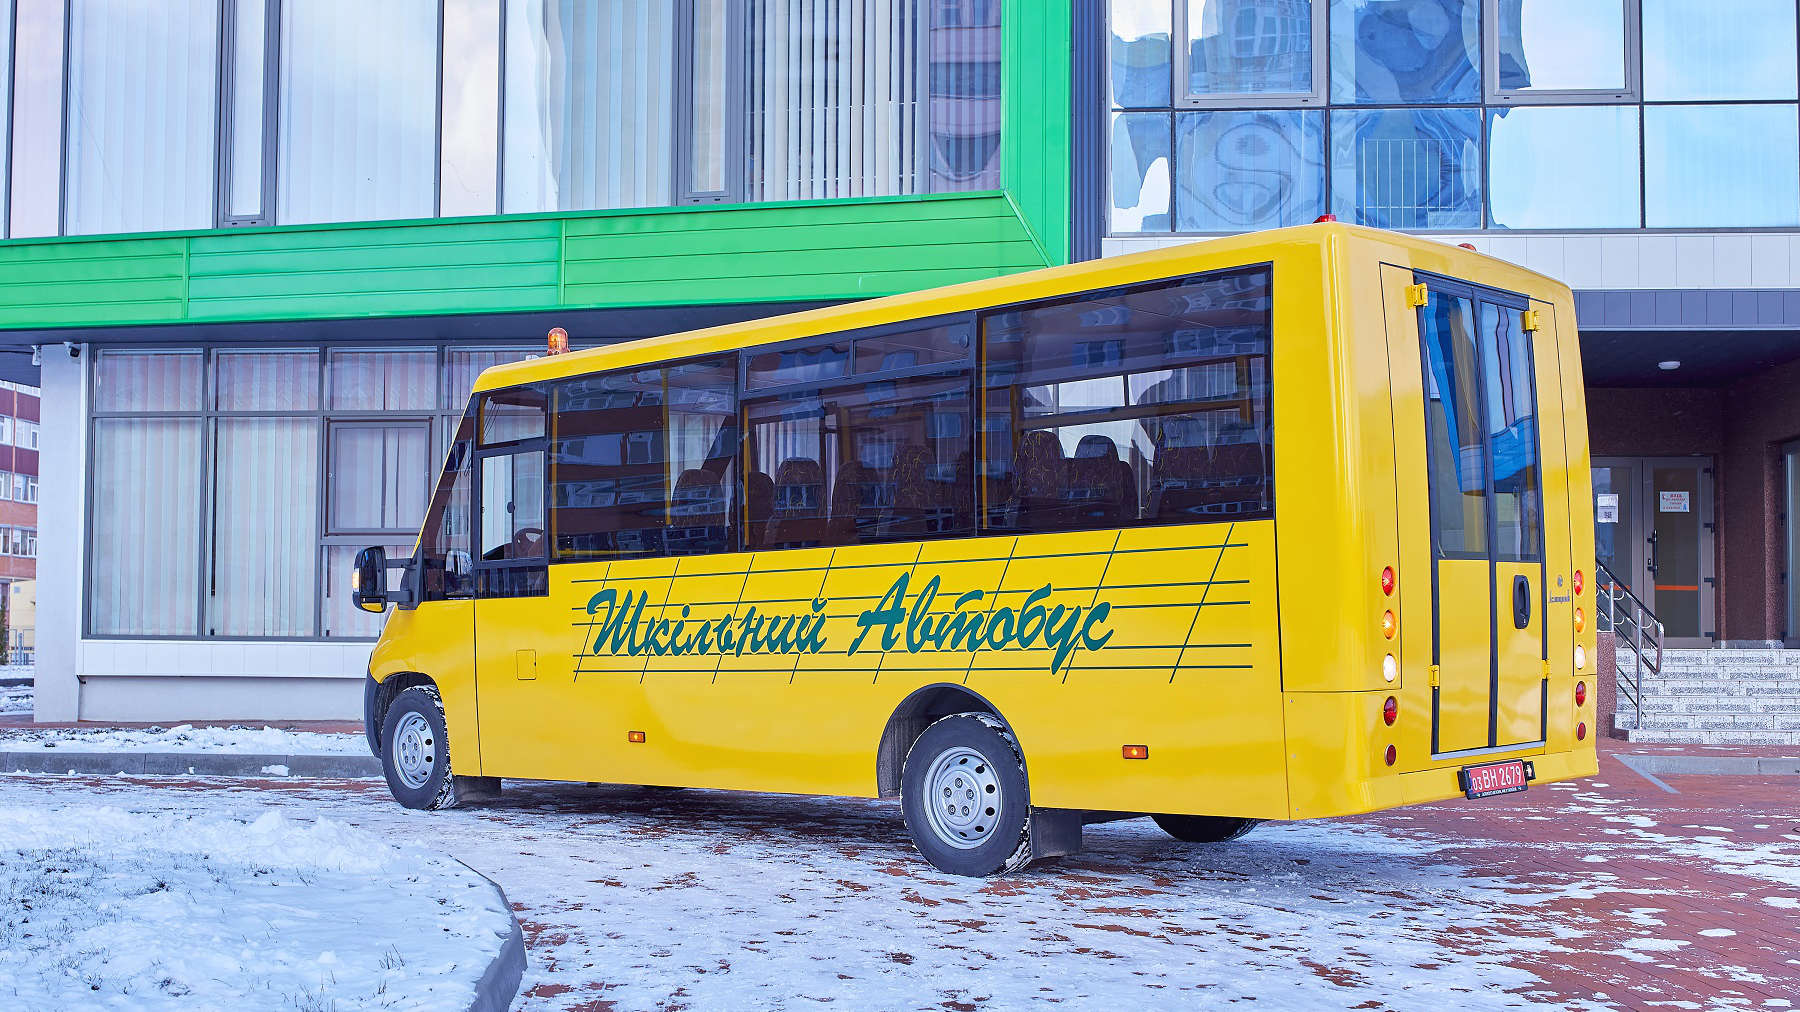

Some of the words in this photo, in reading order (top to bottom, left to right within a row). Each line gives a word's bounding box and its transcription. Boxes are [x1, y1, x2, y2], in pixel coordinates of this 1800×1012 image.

[586, 588, 827, 658] Шкільний
[848, 571, 1114, 675] Автобус
[1499, 765, 1522, 786] 2679
